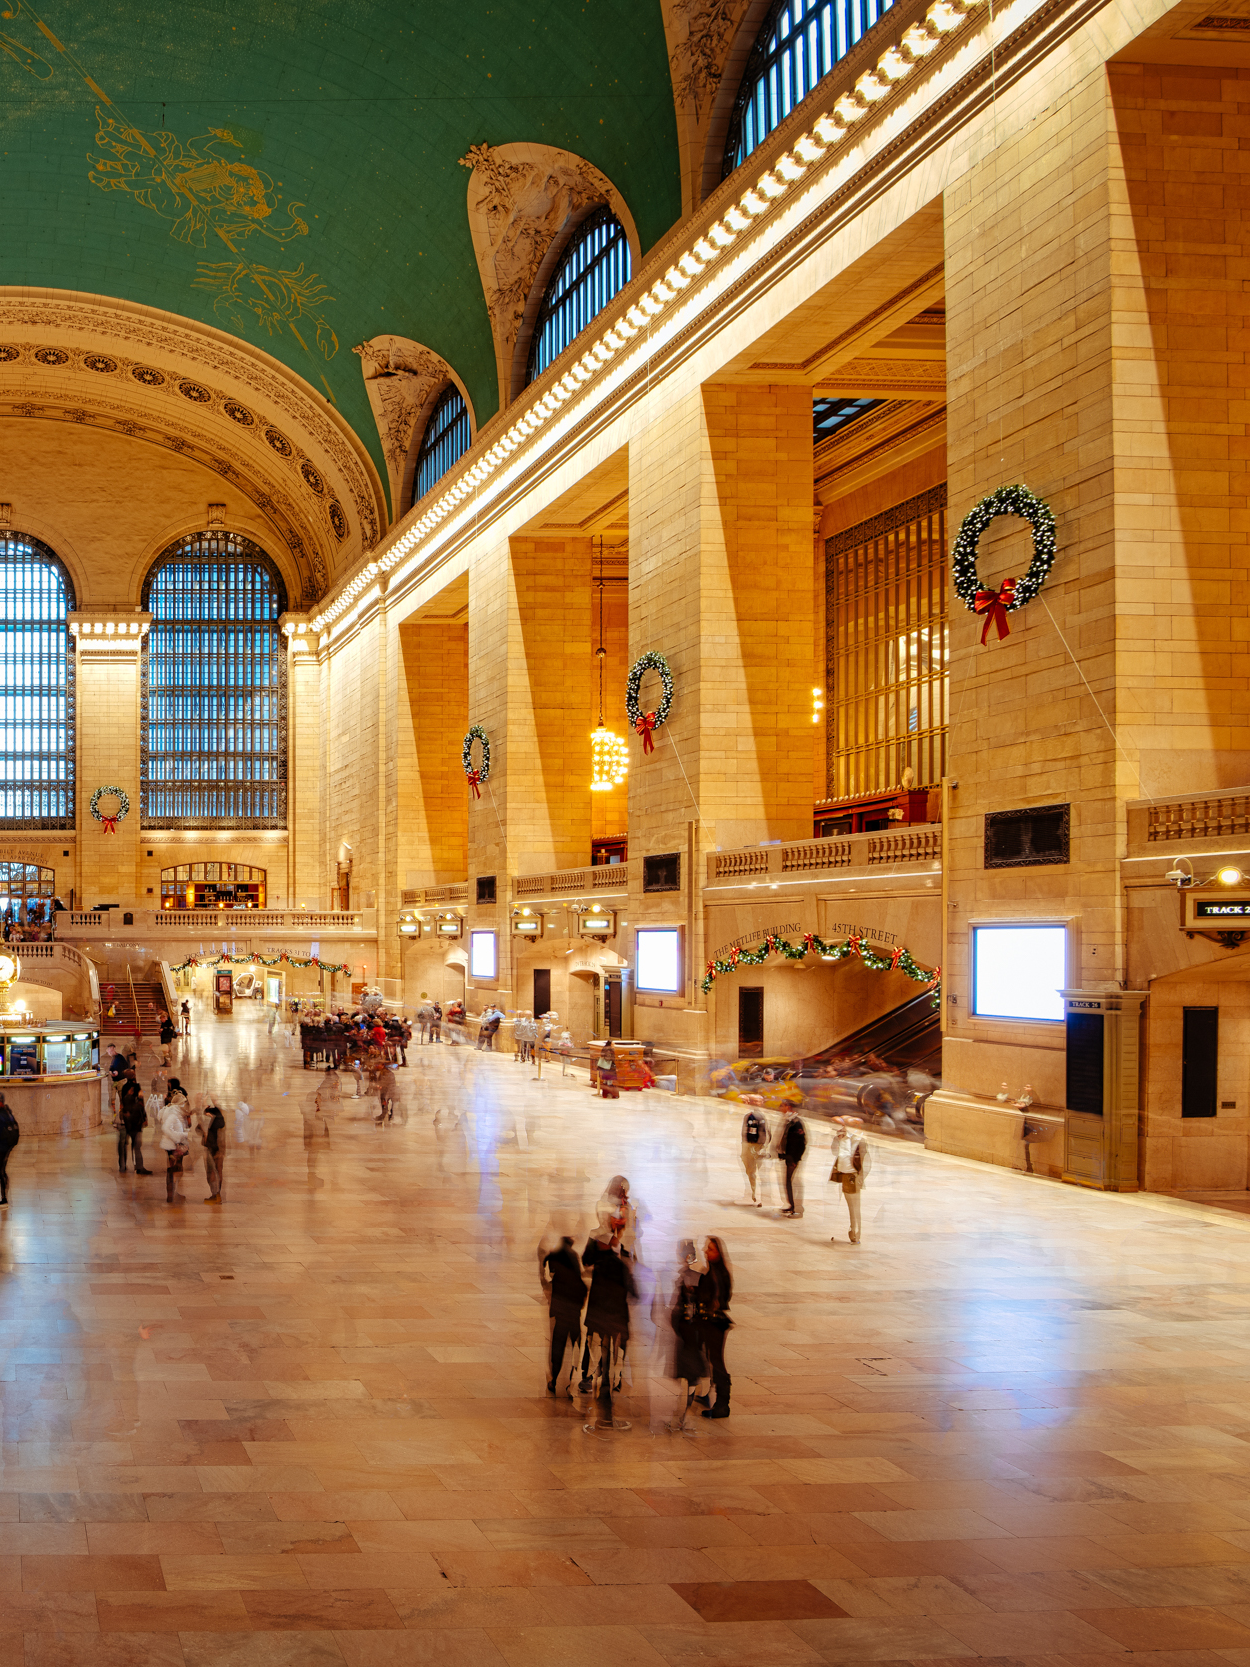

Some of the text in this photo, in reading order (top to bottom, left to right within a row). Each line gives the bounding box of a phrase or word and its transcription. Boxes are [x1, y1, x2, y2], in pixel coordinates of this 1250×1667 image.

[714, 923, 802, 960] THE METLIFE BUILDING
[832, 923, 898, 945] 45TH STREET
